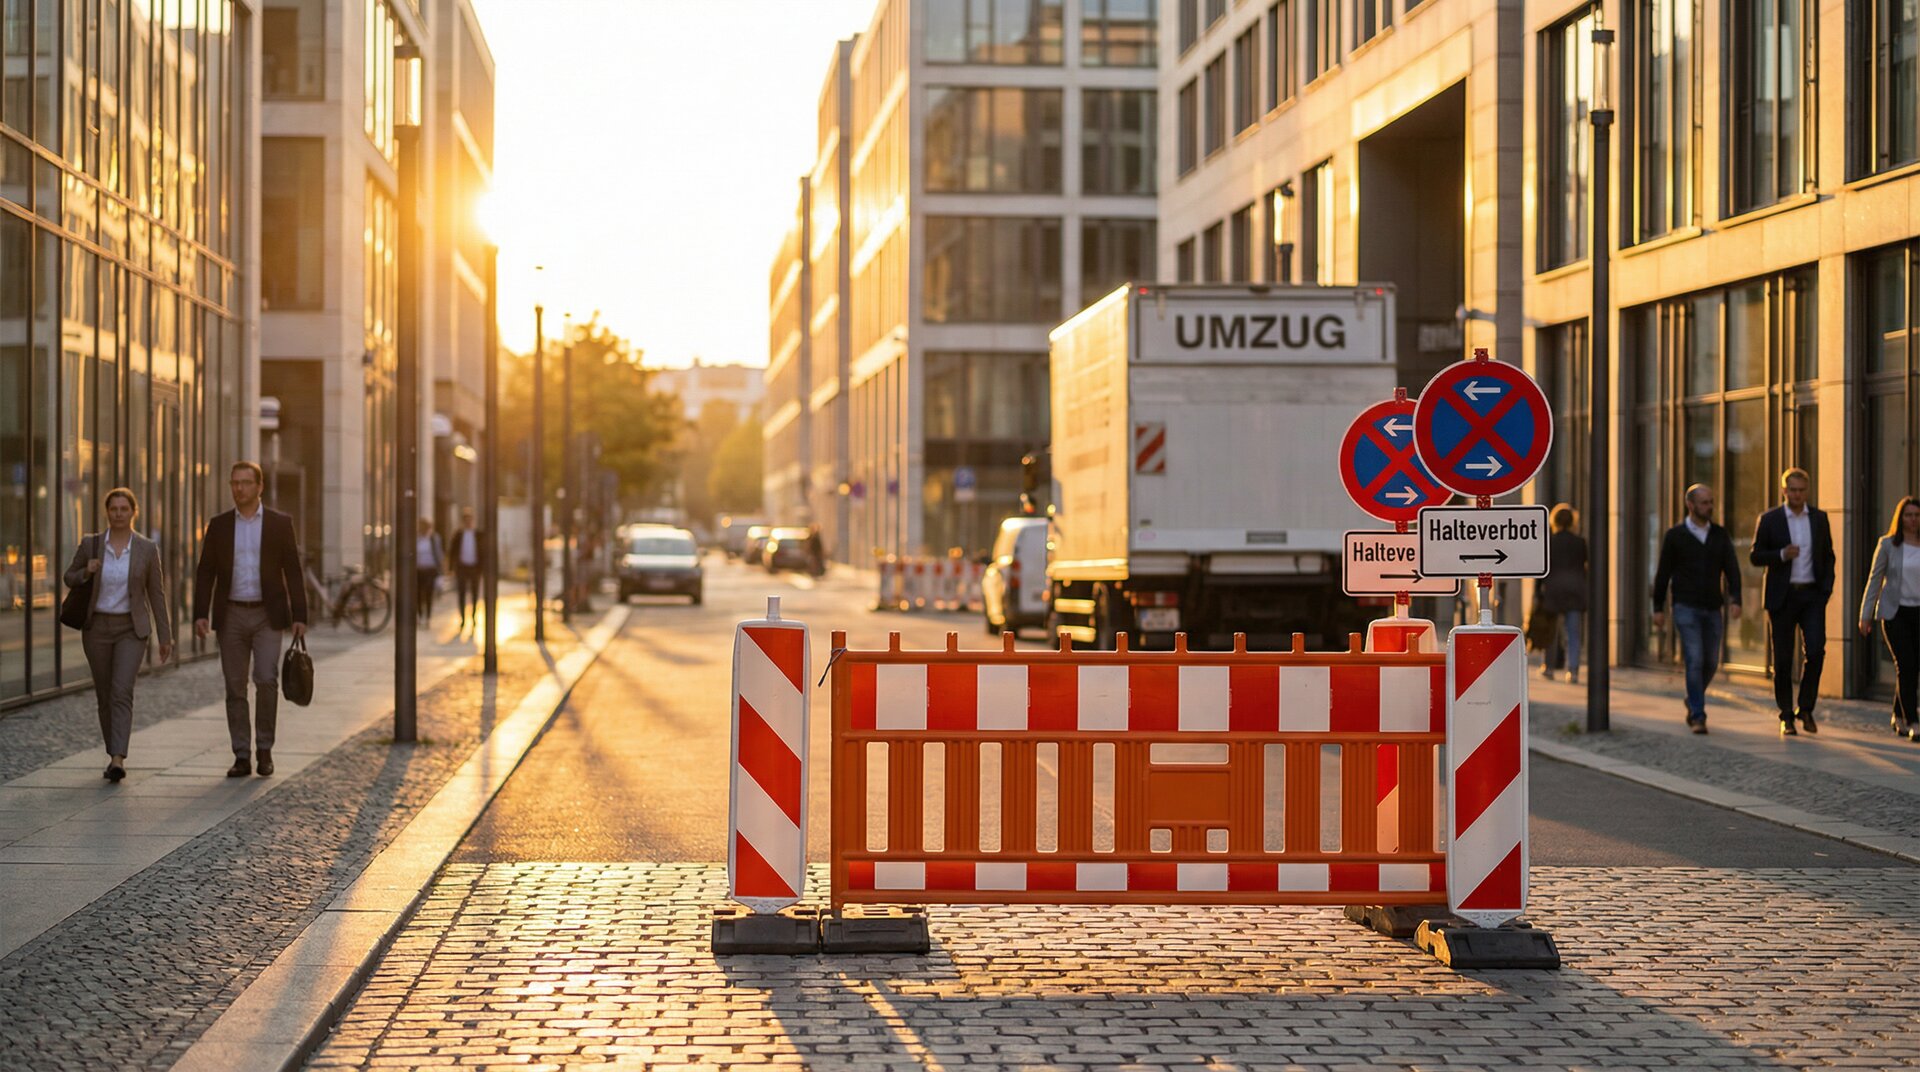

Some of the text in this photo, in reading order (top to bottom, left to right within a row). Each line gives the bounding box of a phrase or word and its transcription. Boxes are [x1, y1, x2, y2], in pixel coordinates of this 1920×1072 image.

[1175, 314, 1346, 350] UMZUG
[1429, 517, 1538, 542] Halteverbot
[1353, 541, 1416, 562] Halteve
